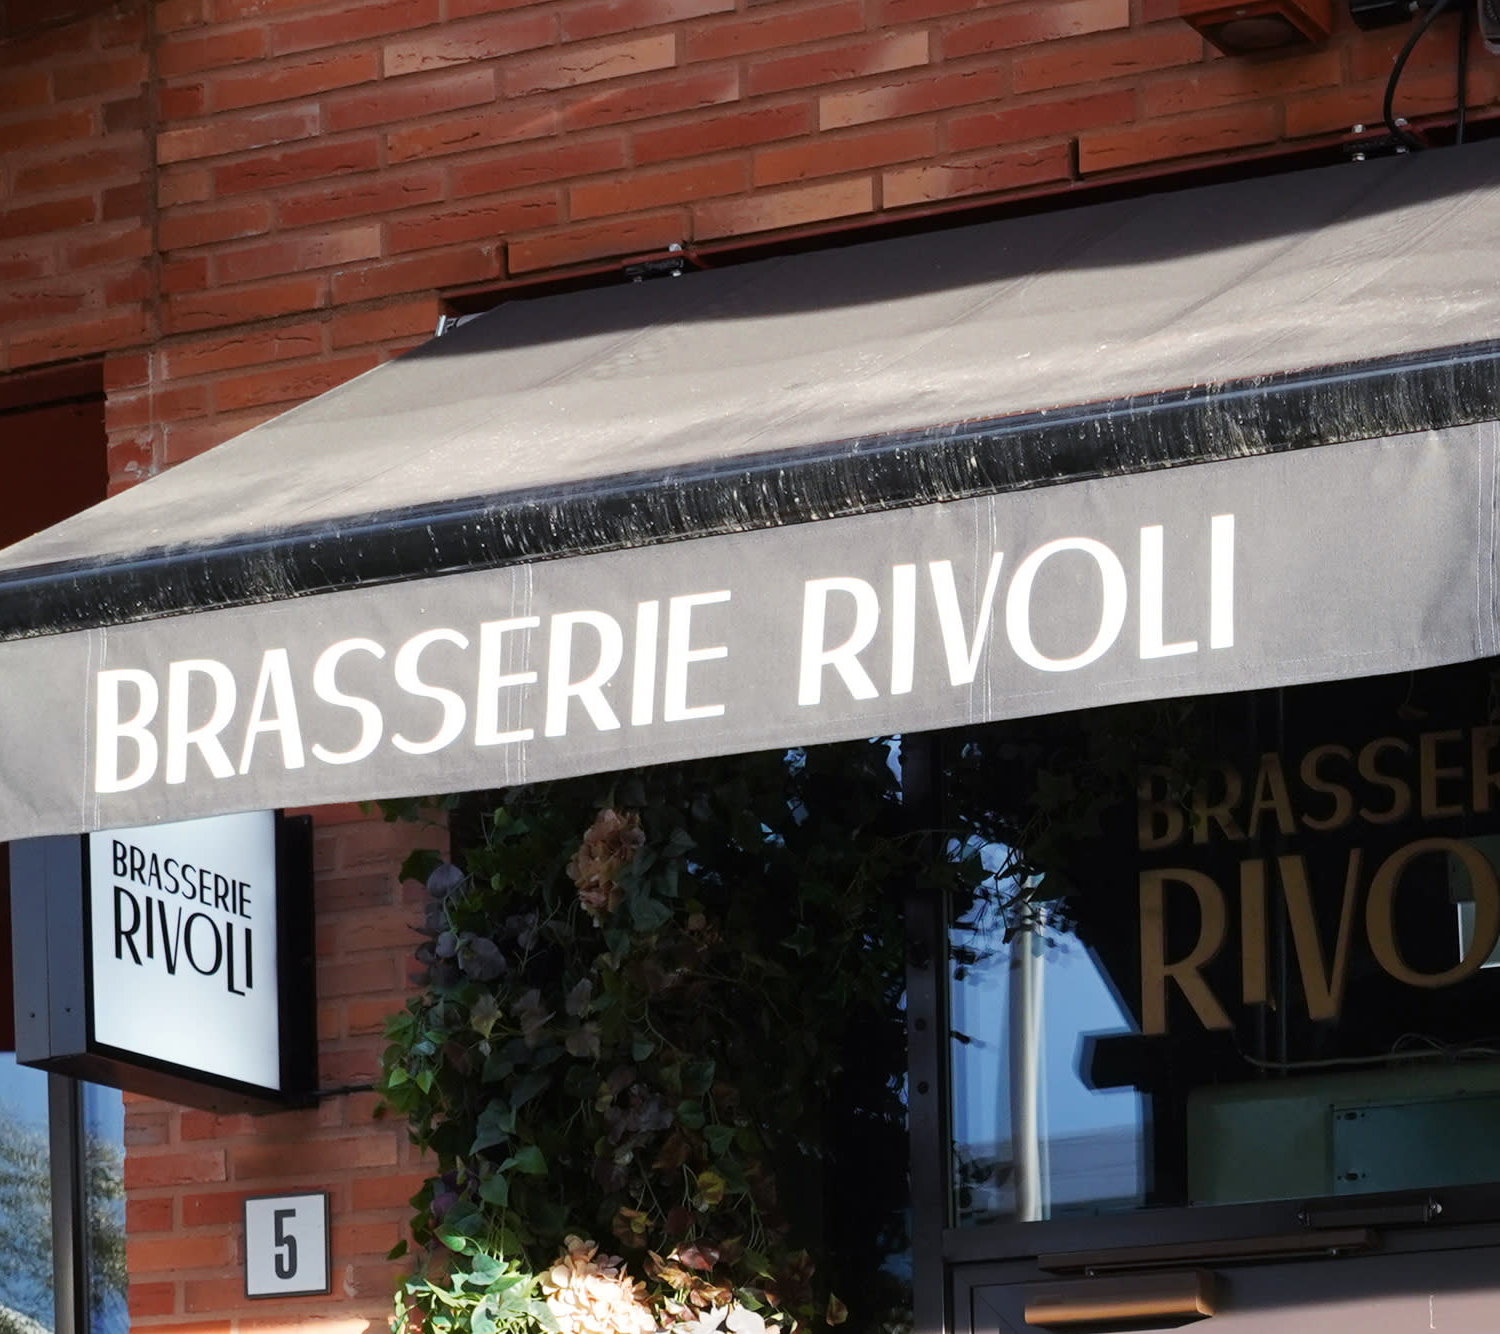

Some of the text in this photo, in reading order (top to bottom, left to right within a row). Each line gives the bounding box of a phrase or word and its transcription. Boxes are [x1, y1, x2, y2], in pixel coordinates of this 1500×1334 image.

[95, 514, 1235, 793] BRASSERIE RIVOLI
[112, 839, 252, 920] BRASSERIE
[113, 885, 253, 997] RIVOLI
[274, 1208, 298, 1280] 5
